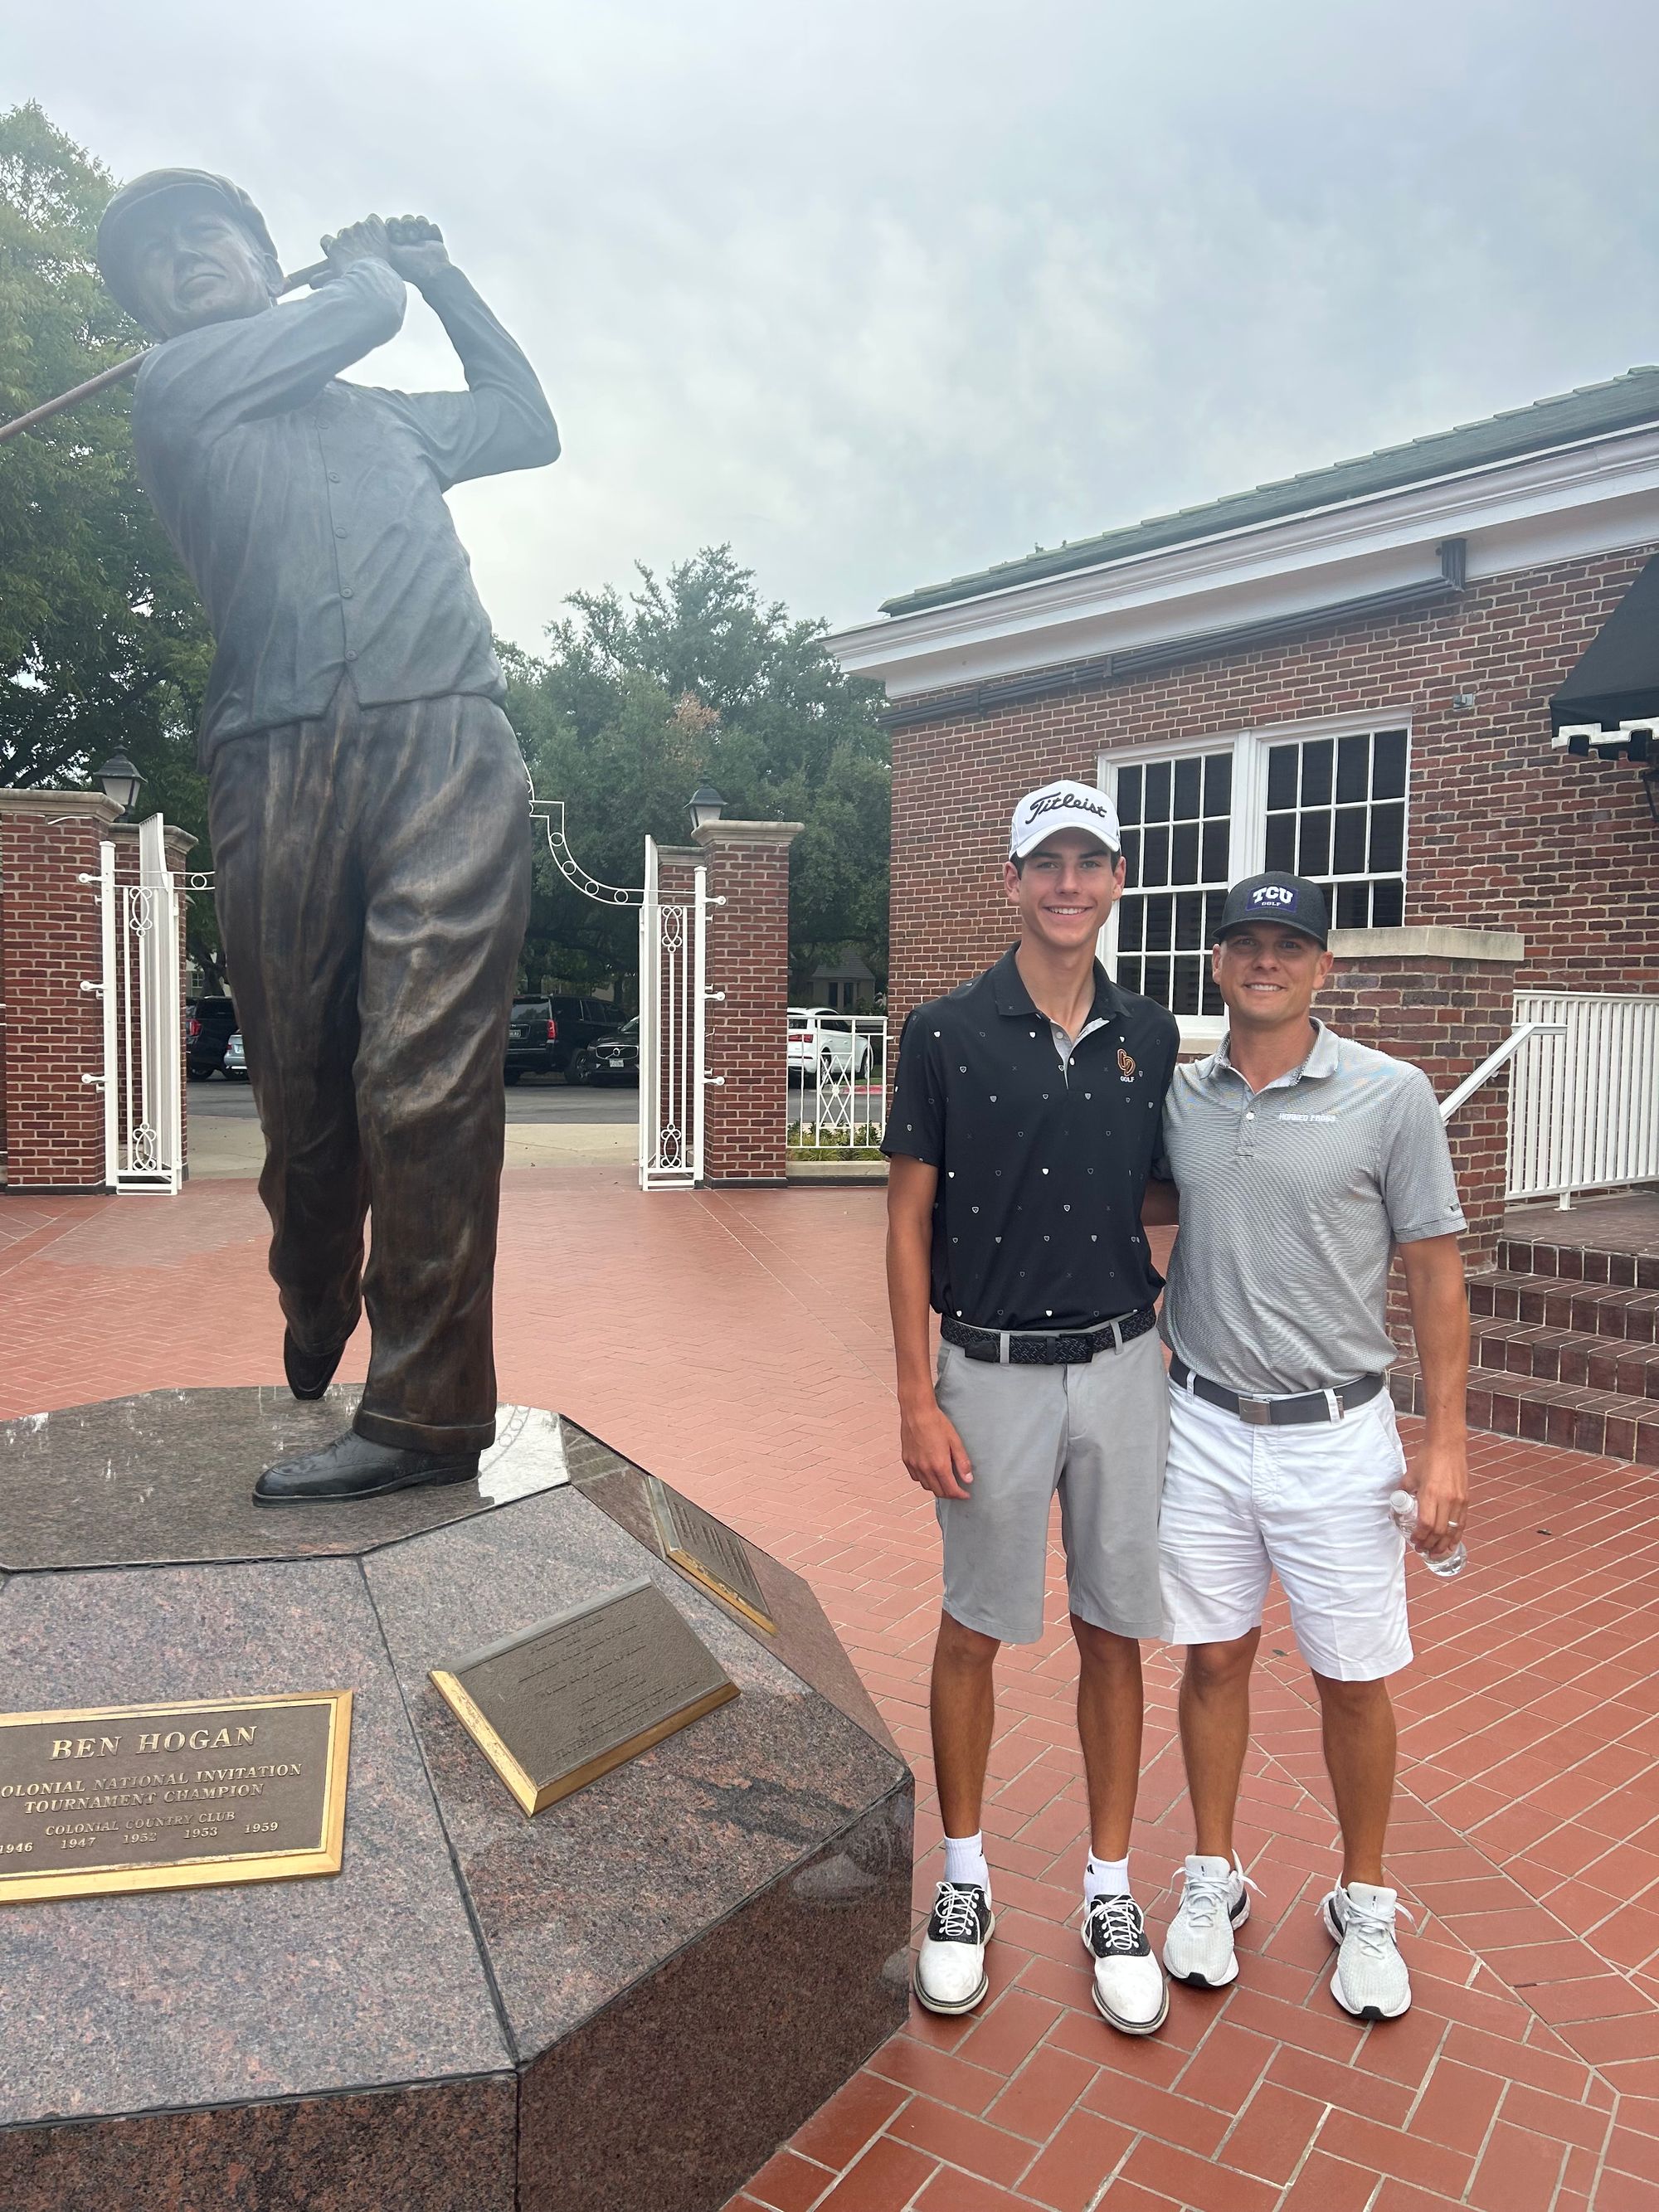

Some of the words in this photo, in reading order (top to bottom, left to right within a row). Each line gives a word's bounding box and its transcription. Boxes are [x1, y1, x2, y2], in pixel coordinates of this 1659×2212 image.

[1024, 791, 1107, 824] Titleist
[1253, 886, 1294, 904] TCU
[49, 1736, 123, 1762] BEN
[135, 1725, 259, 1756] HOGAN
[0, 1780, 85, 1798] OLONIAL
[92, 1772, 189, 1791] NATIONAL
[194, 1763, 303, 1783] INVITATION
[24, 1791, 158, 1815] TOURNAMENT
[163, 1783, 265, 1803] CHAMPION
[0, 1842, 33, 1855] 1946
[61, 1837, 96, 1850] 1947
[122, 1832, 158, 1845] 1952
[182, 1826, 218, 1840] 1953
[243, 1821, 279, 1835] 1959
[46, 1821, 119, 1836] COLONIAL
[125, 1815, 194, 1830] COUNTRY
[198, 1811, 236, 1824] CLUB
